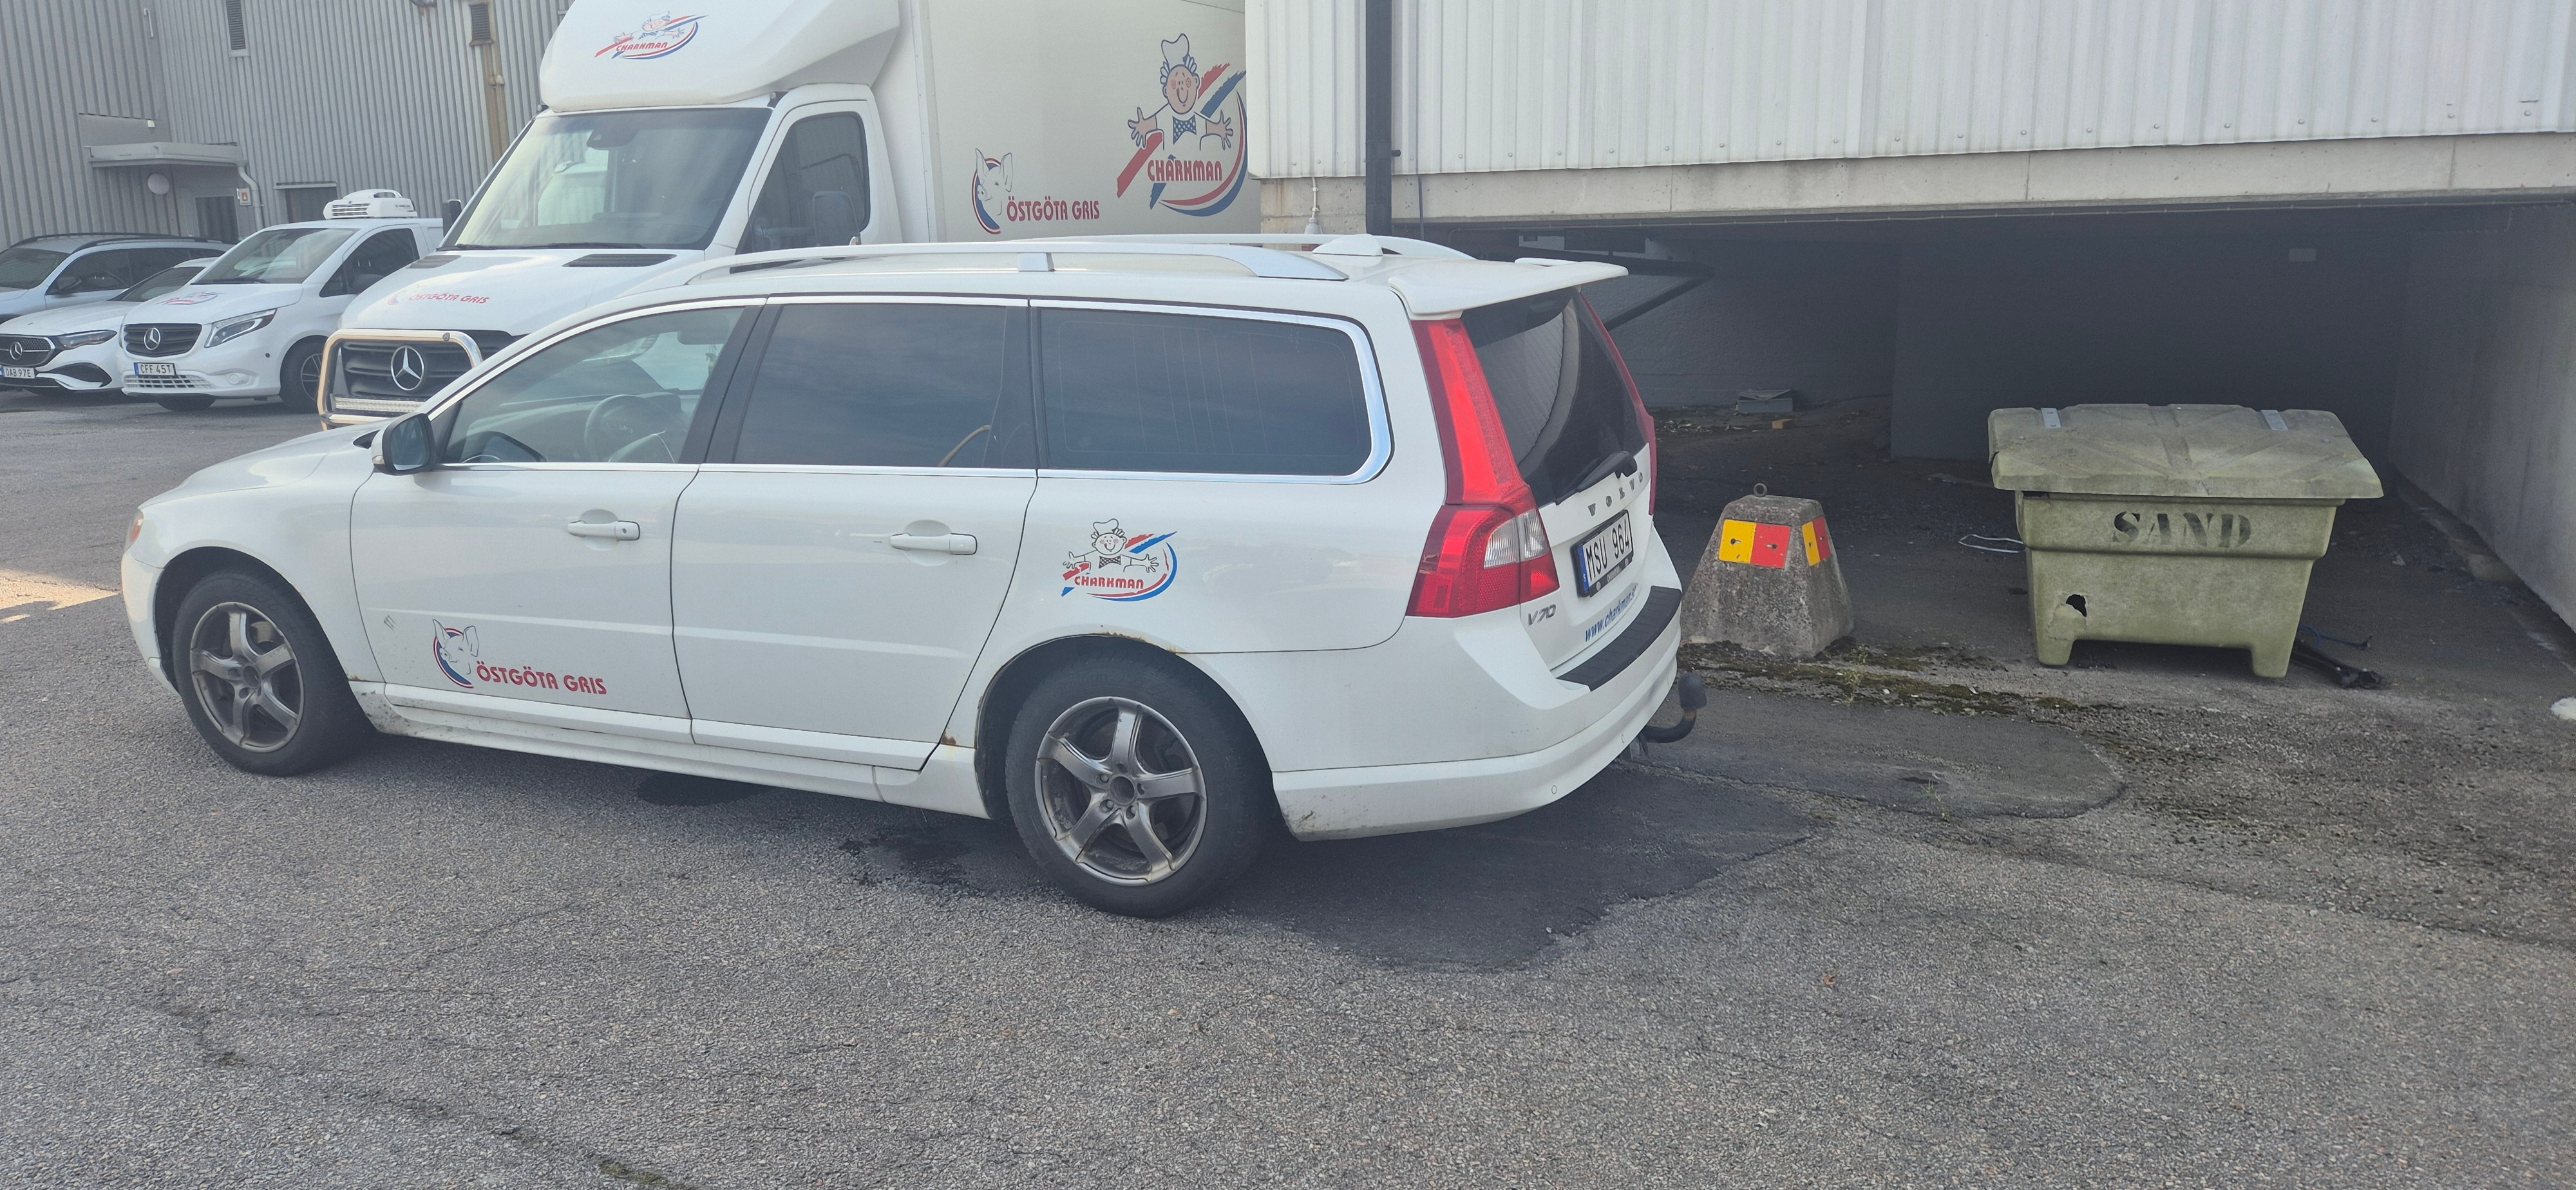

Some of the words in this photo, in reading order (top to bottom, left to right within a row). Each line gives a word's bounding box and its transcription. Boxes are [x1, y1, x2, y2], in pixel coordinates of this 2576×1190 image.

[616, 42, 668, 52] CHARKMAN
[1147, 159, 1222, 182] CHARKMAN
[1007, 195, 1068, 222] ÖSTGÖTA
[1072, 200, 1100, 220] GRIS
[460, 296, 490, 304] GRIS
[18, 369, 31, 377] 97E
[140, 364, 153, 373] CFF
[156, 365, 171, 373] 45T
[1588, 472, 1643, 516] VOLVO
[2112, 511, 2251, 548] SAND
[1586, 536, 1607, 581] MSU
[1613, 519, 1629, 559] 964
[1074, 576, 1144, 589] CHARKMAN
[1528, 604, 1556, 626] V70
[477, 661, 559, 690] ÖSTGÖTA
[564, 675, 607, 695] GRIS
